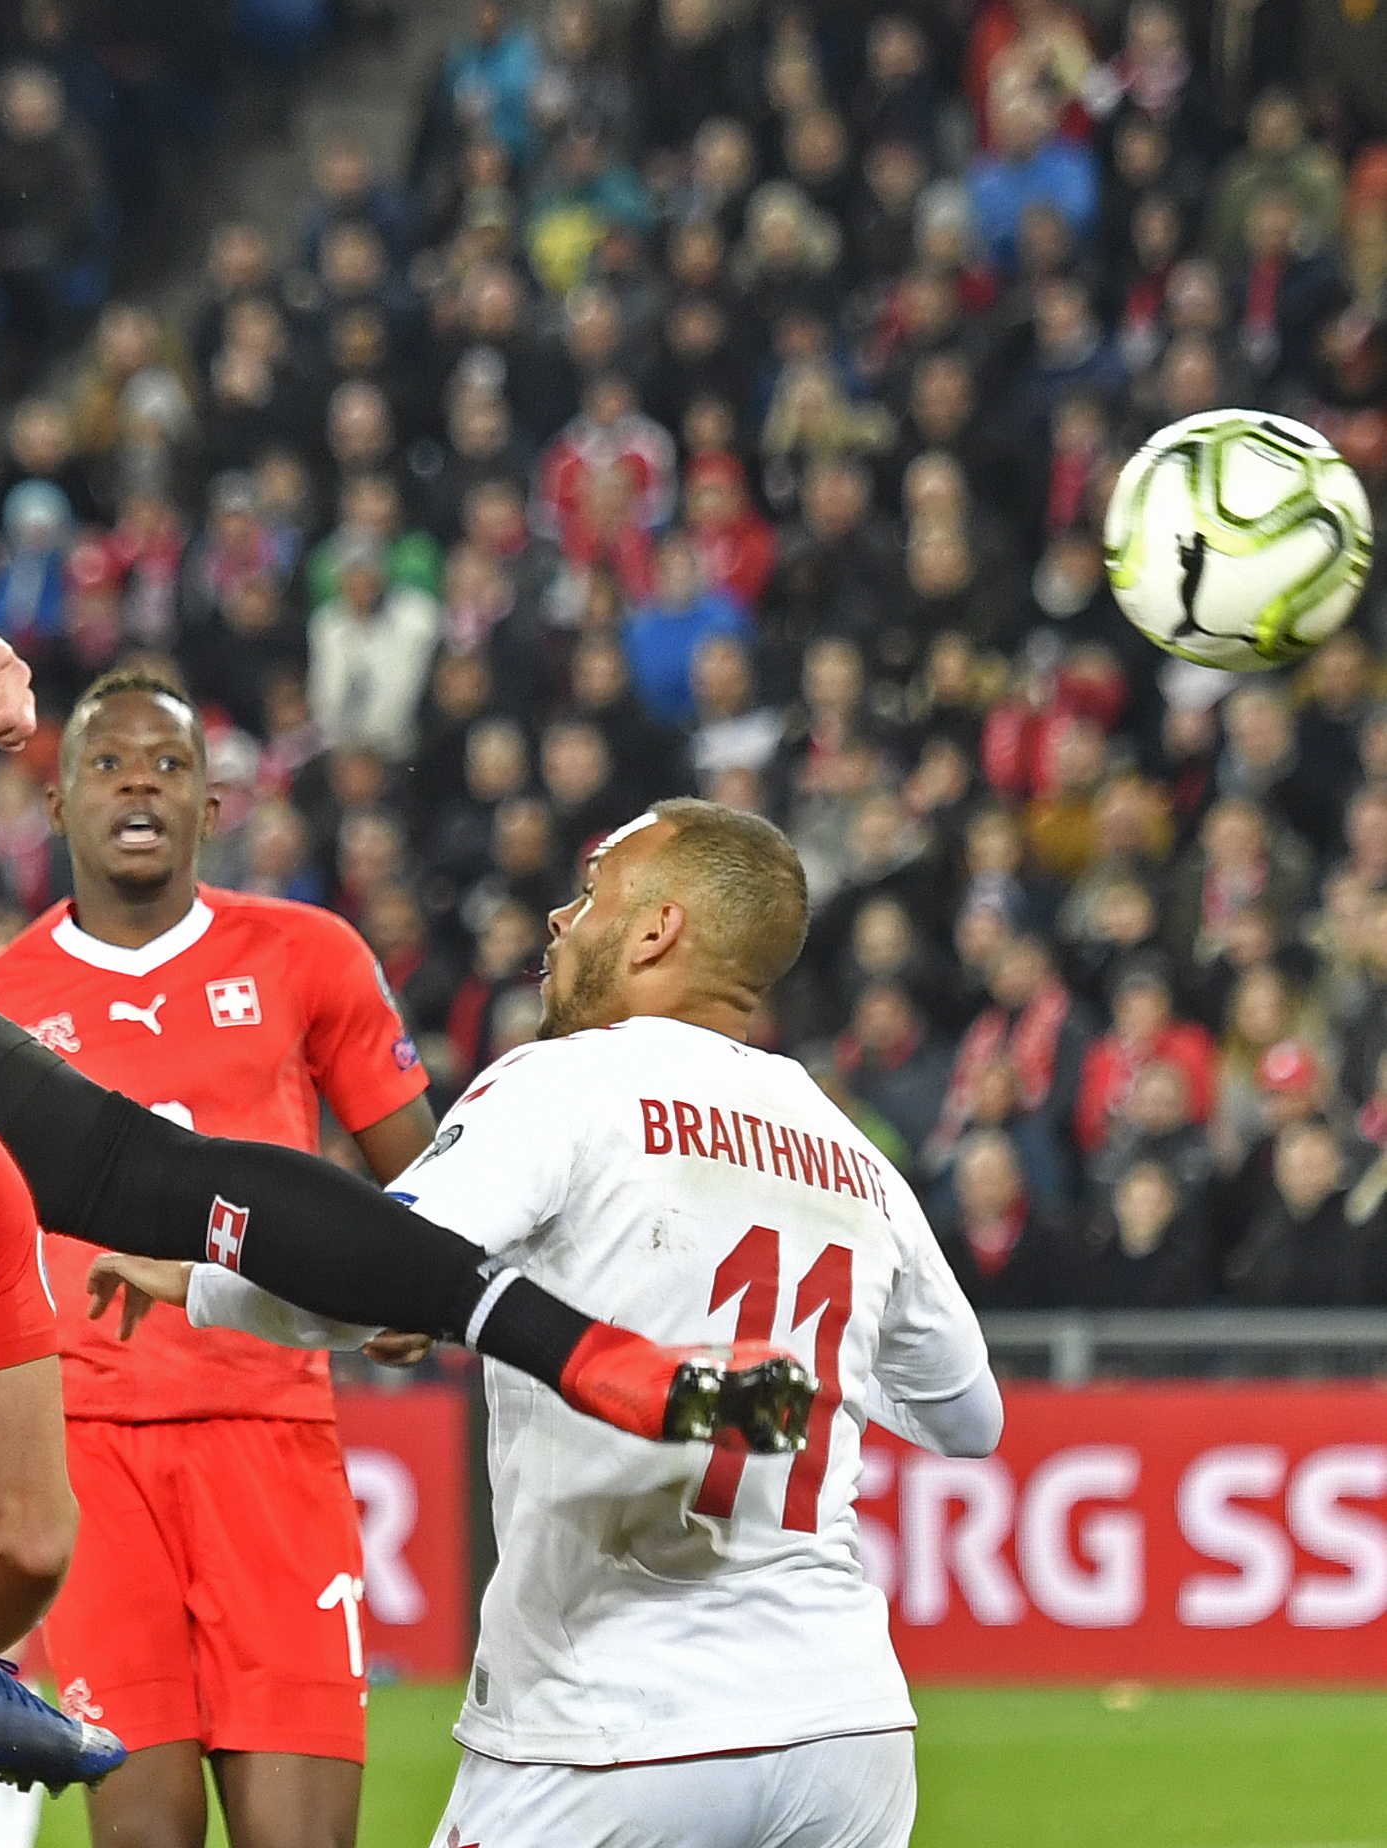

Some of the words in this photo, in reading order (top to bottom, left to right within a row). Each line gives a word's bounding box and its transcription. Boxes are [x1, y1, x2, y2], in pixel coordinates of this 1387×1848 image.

[639, 1098, 891, 1222] BRAITHWAITE
[694, 1224, 854, 1535] 11
[316, 1571, 364, 1677] 1
